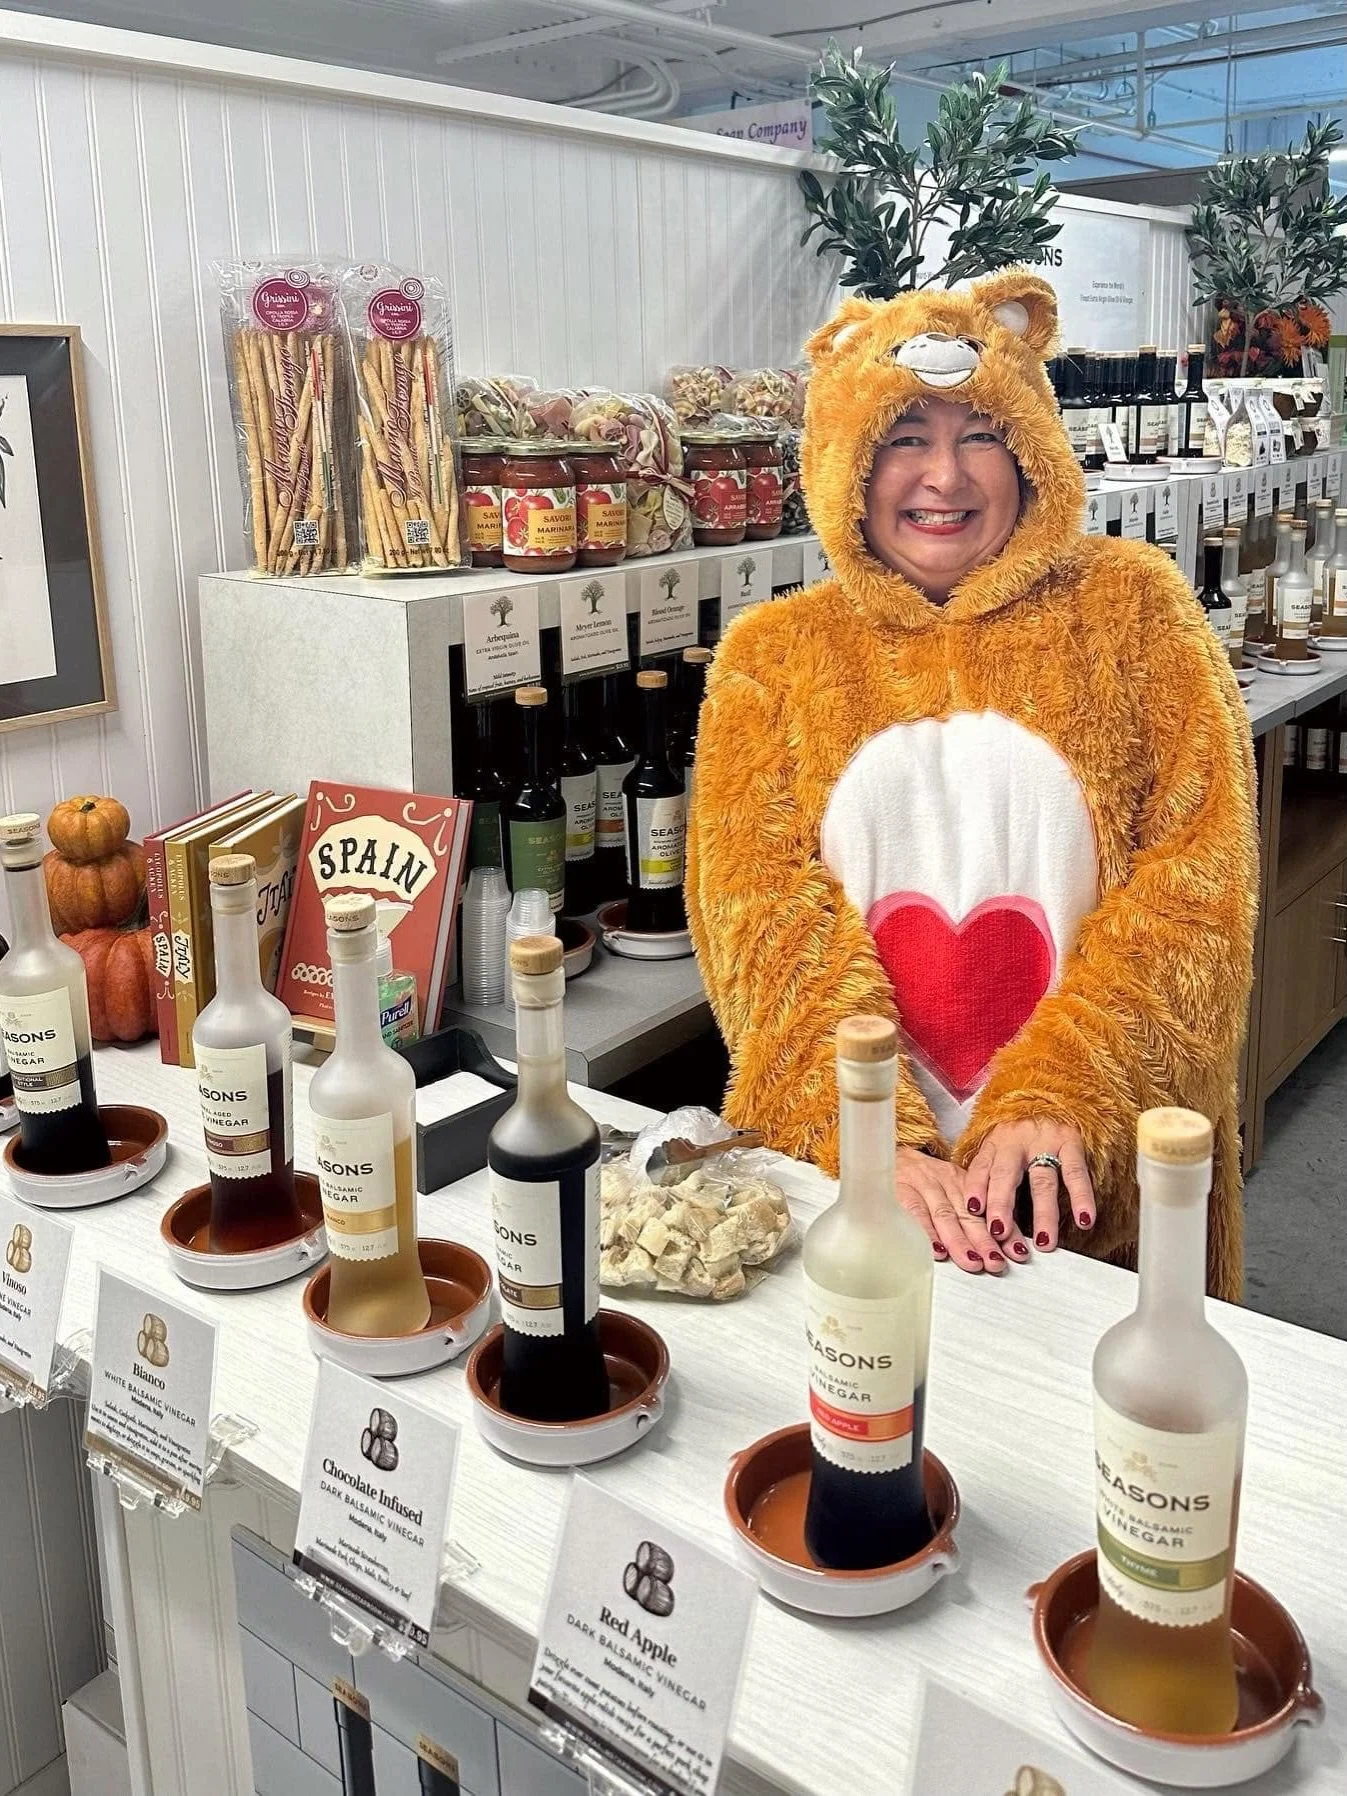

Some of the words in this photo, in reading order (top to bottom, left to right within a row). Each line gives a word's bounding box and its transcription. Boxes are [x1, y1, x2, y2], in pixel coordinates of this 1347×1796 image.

[748, 119, 808, 144] Company
[261, 291, 300, 306] Grissini
[376, 302, 413, 316] Grissini
[543, 515, 572, 524] SAVORI
[652, 607, 667, 616] Blood
[668, 605, 685, 615] Orange
[487, 630, 520, 643] Arbequina
[576, 622, 593, 632] Meyer
[594, 619, 612, 628] Lemon
[319, 838, 427, 894] SPAIN
[155, 934, 170, 973] SPAIN
[174, 935, 190, 980] ITALY
[381, 1001, 410, 1026] Purell
[206, 1117, 250, 1127] VINEGAR
[214, 1110, 232, 1118] AGED
[2, 1270, 27, 1296] Vinoso
[7, 1298, 32, 1317] VINEGAR
[13, 1311, 22, 1323] Italy
[806, 1324, 893, 1370] EASONS
[133, 1362, 166, 1391] Bianco
[812, 1372, 872, 1403] VINEGAR
[104, 1370, 126, 1388] WHITE
[128, 1384, 163, 1406] BALSAMIC
[164, 1404, 196, 1427] VINEGAR
[131, 1394, 152, 1412] Modena,
[152, 1407, 164, 1420] Italy
[832, 1418, 860, 1432] APPLE
[322, 1458, 378, 1500] Chocolate
[378, 1488, 423, 1526] Infused
[320, 1480, 342, 1498] DARK
[344, 1493, 385, 1524] BALSAMIC
[388, 1520, 424, 1548] VINEGAR
[1104, 1506, 1185, 1548] VINEGAR
[1129, 1515, 1194, 1535] BALSAMIC
[348, 1514, 372, 1534] Modena,
[374, 1528, 388, 1542] Italy
[600, 1606, 630, 1637] Red
[630, 1628, 678, 1668] Apple
[567, 1614, 596, 1640] DARK
[600, 1634, 654, 1678] BALSAMIC
[657, 1670, 706, 1712] VINEGAR
[604, 1656, 636, 1686] Modena,
[636, 1680, 655, 1700] Italy
